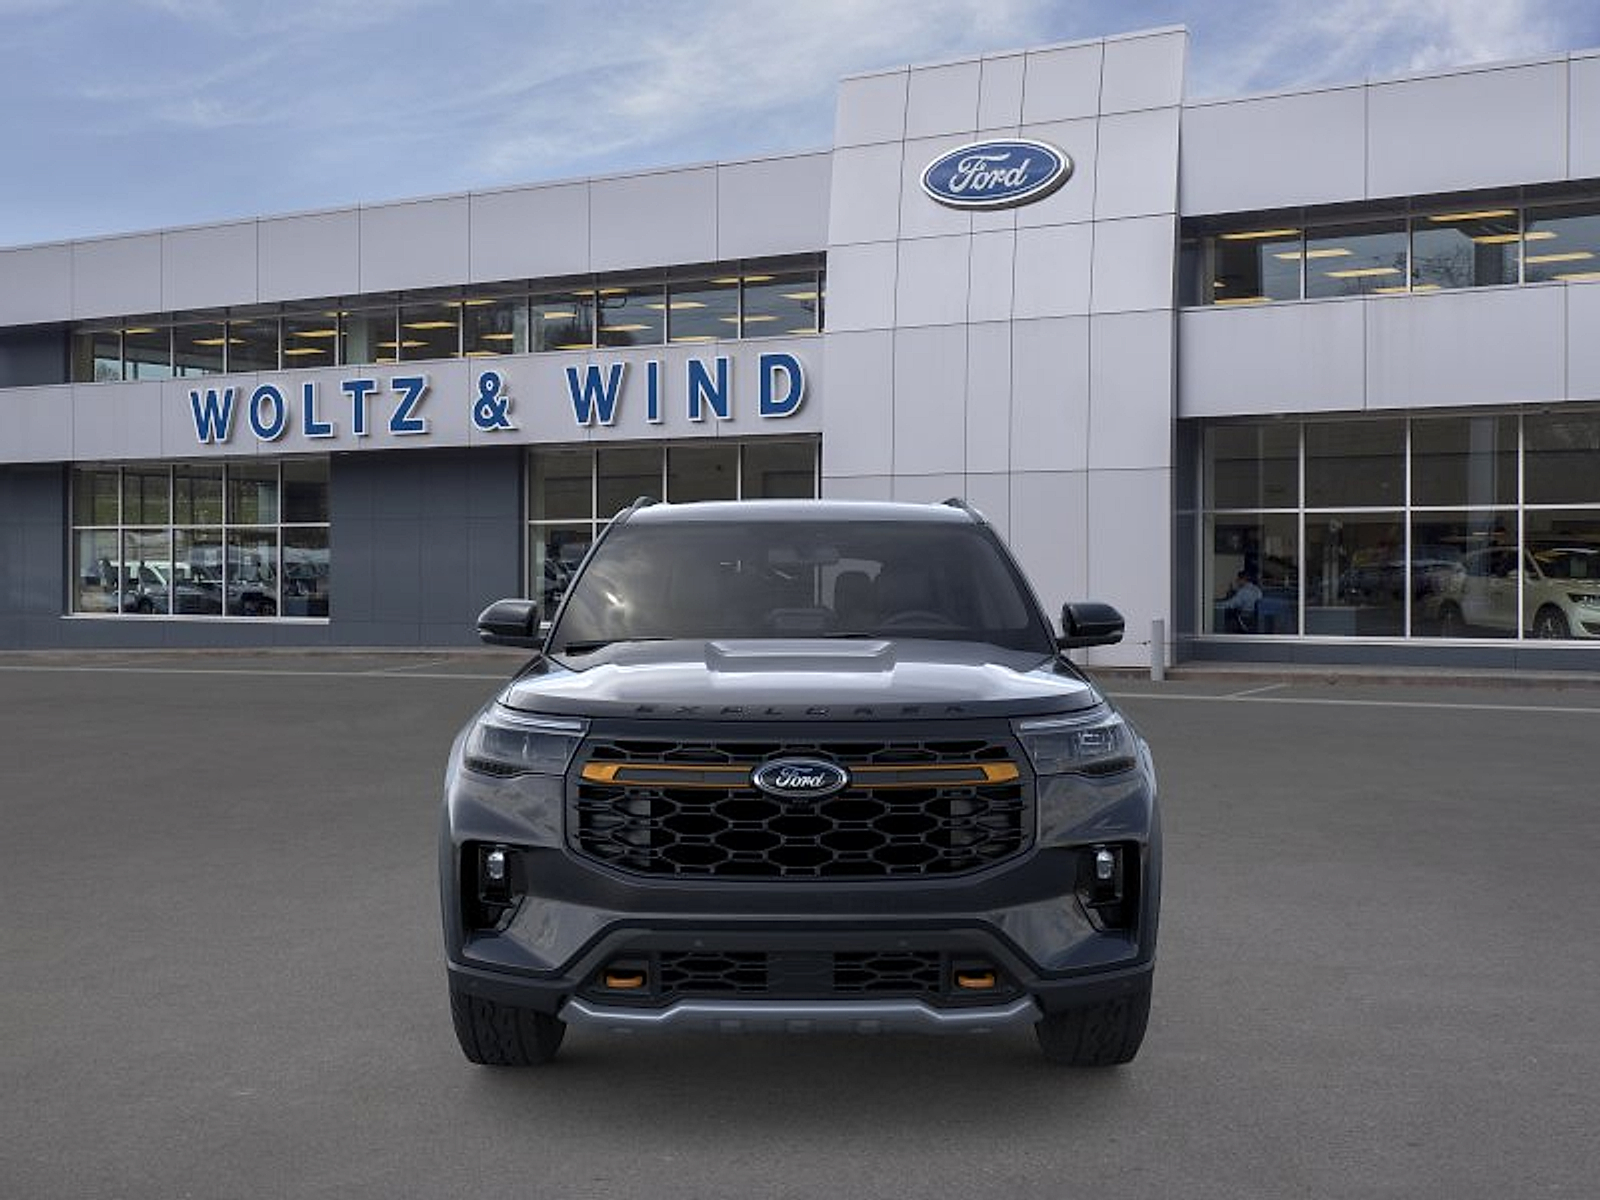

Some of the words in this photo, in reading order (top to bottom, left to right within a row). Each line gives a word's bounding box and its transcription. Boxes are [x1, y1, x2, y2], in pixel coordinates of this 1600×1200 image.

[949, 152, 1031, 193] Ford
[189, 374, 431, 444] WOLTZ
[473, 370, 517, 430] &
[565, 353, 807, 426] WIND
[775, 765, 826, 788] Ford
